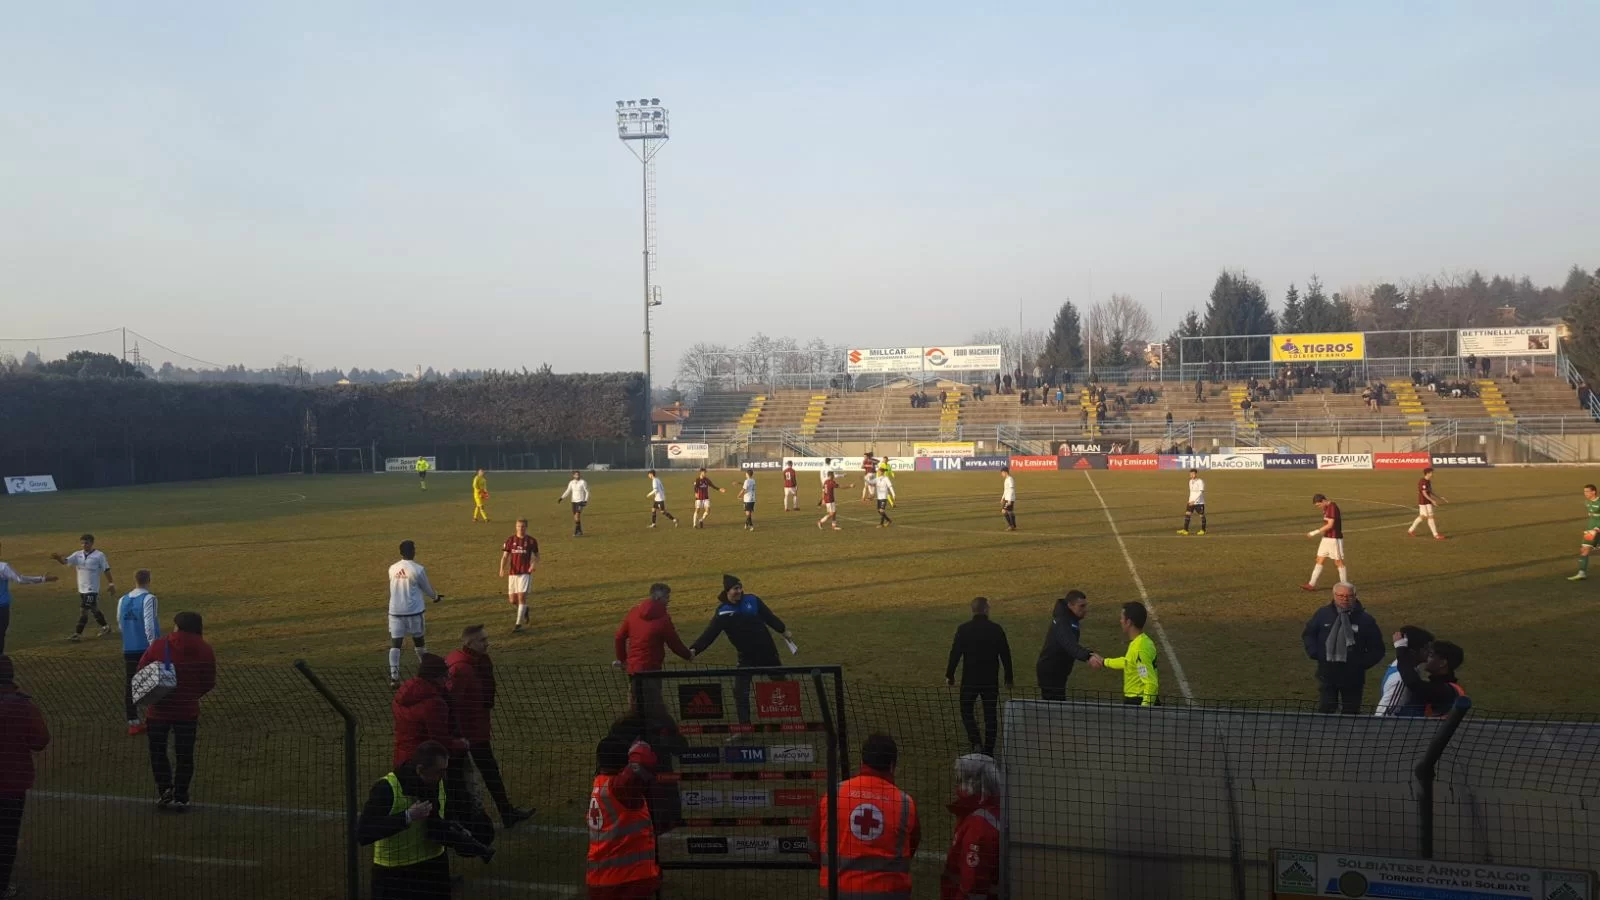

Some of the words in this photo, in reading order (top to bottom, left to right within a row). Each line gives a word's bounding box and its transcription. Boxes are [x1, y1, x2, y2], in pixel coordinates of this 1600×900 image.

[1462, 329, 1512, 337] BETTINELLI
[870, 348, 907, 356] MILLCAR
[953, 349, 968, 357] FOOD
[968, 348, 1000, 356] MACHINERY
[1303, 343, 1354, 354] TIGROS
[1071, 443, 1101, 452] MILAN
[742, 459, 782, 469] DIESEL
[933, 457, 961, 470] TIM
[1011, 459, 1024, 468] Fly
[1024, 459, 1057, 467] Emirates
[1109, 458, 1122, 467] Fly
[1123, 458, 1158, 466] Emirates
[1181, 455, 1210, 469] TIM
[1211, 460, 1244, 468] BANCO
[1244, 460, 1263, 468] BPM
[1321, 455, 1369, 464] PREMIUM
[1432, 456, 1486, 465] DIESEL
[740, 749, 763, 760] TIM
[1337, 857, 1425, 874] SOLBIATESE
[1428, 863, 1471, 878] ARNO
[1474, 867, 1531, 882] CALCIO
[1378, 872, 1425, 883] TORNEO
[1475, 879, 1531, 892] SOLBIATE
